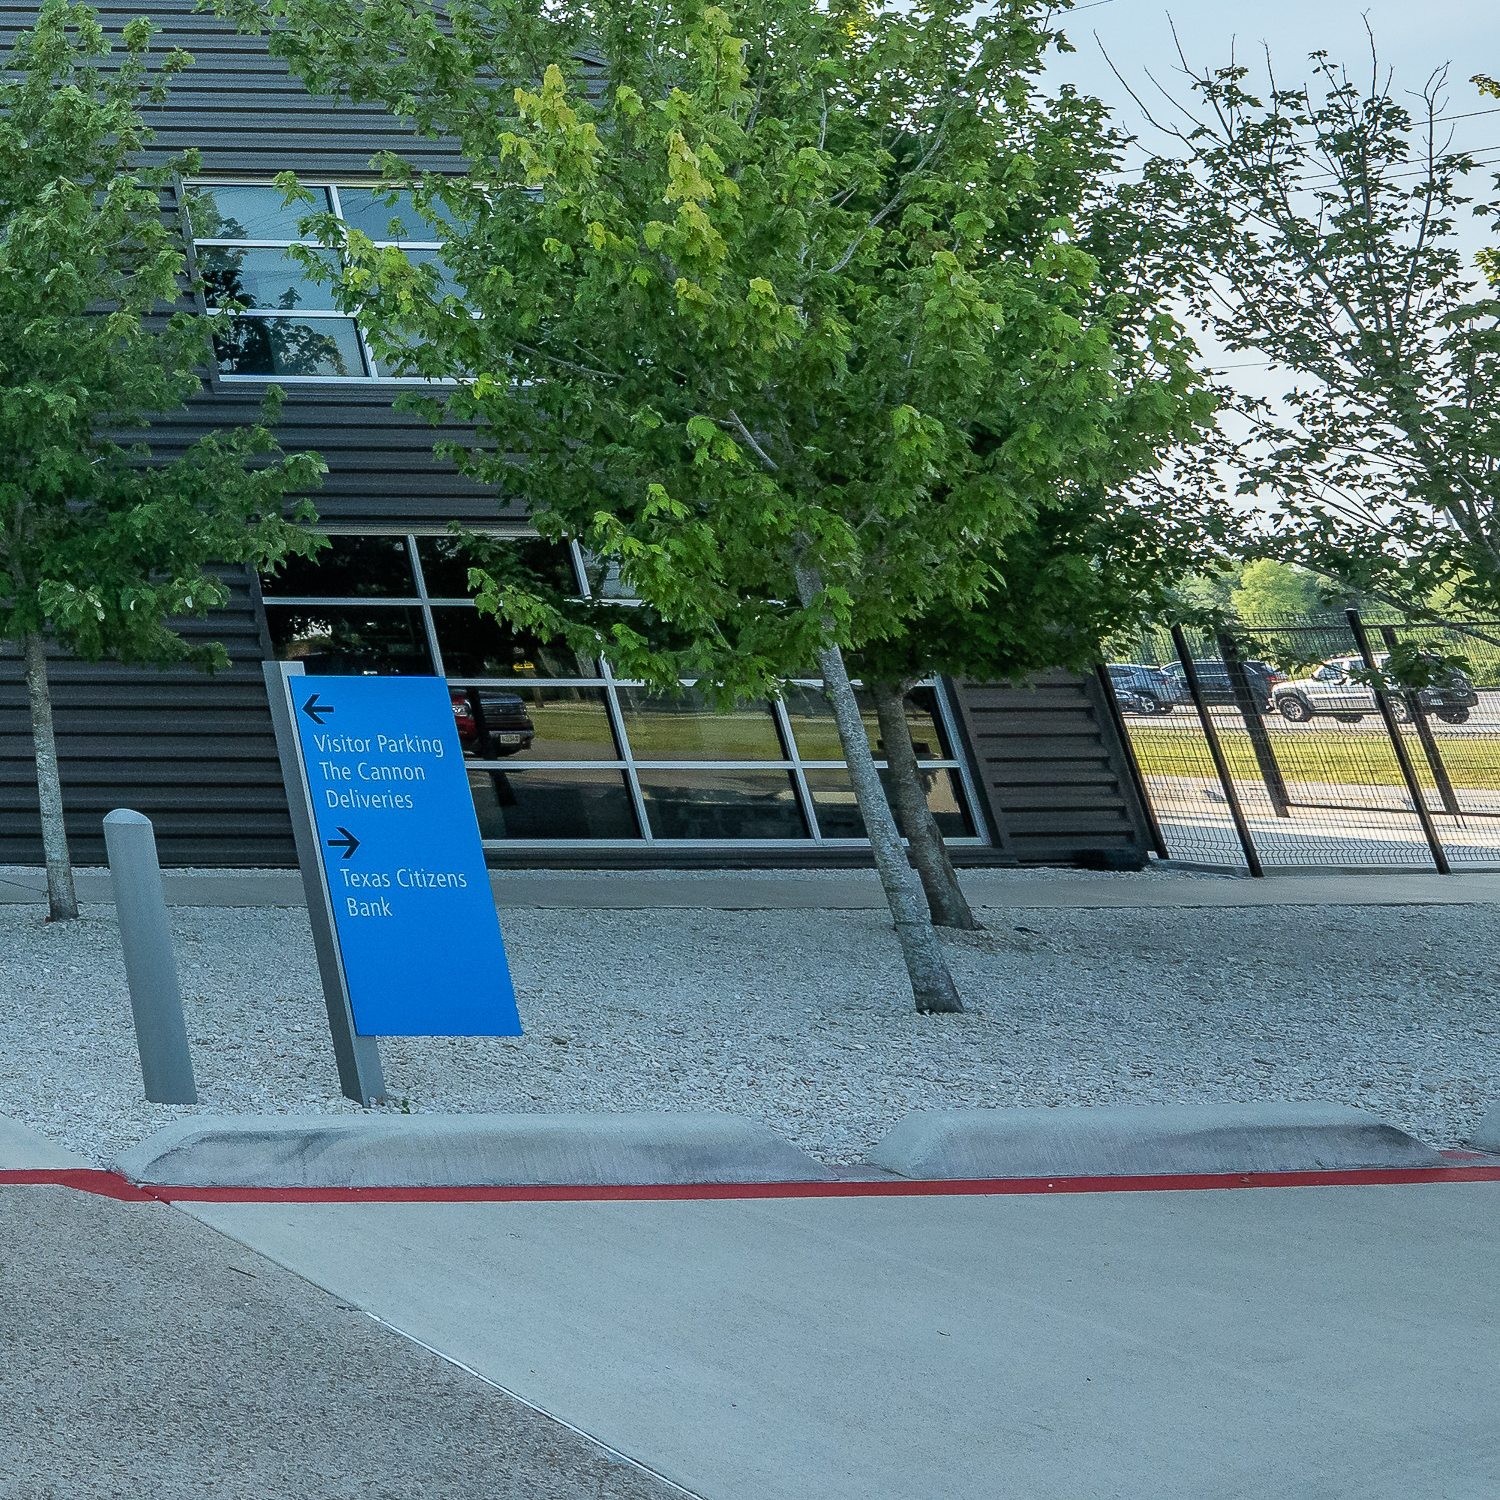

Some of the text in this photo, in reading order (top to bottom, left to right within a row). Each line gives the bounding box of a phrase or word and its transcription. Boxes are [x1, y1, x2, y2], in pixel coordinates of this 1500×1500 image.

[313, 734, 443, 757] Visitor Parking
[319, 761, 425, 781] The Cannon
[326, 789, 414, 809] Deliveries
[340, 868, 468, 888] Texas Citizens
[347, 897, 393, 917] Bank
